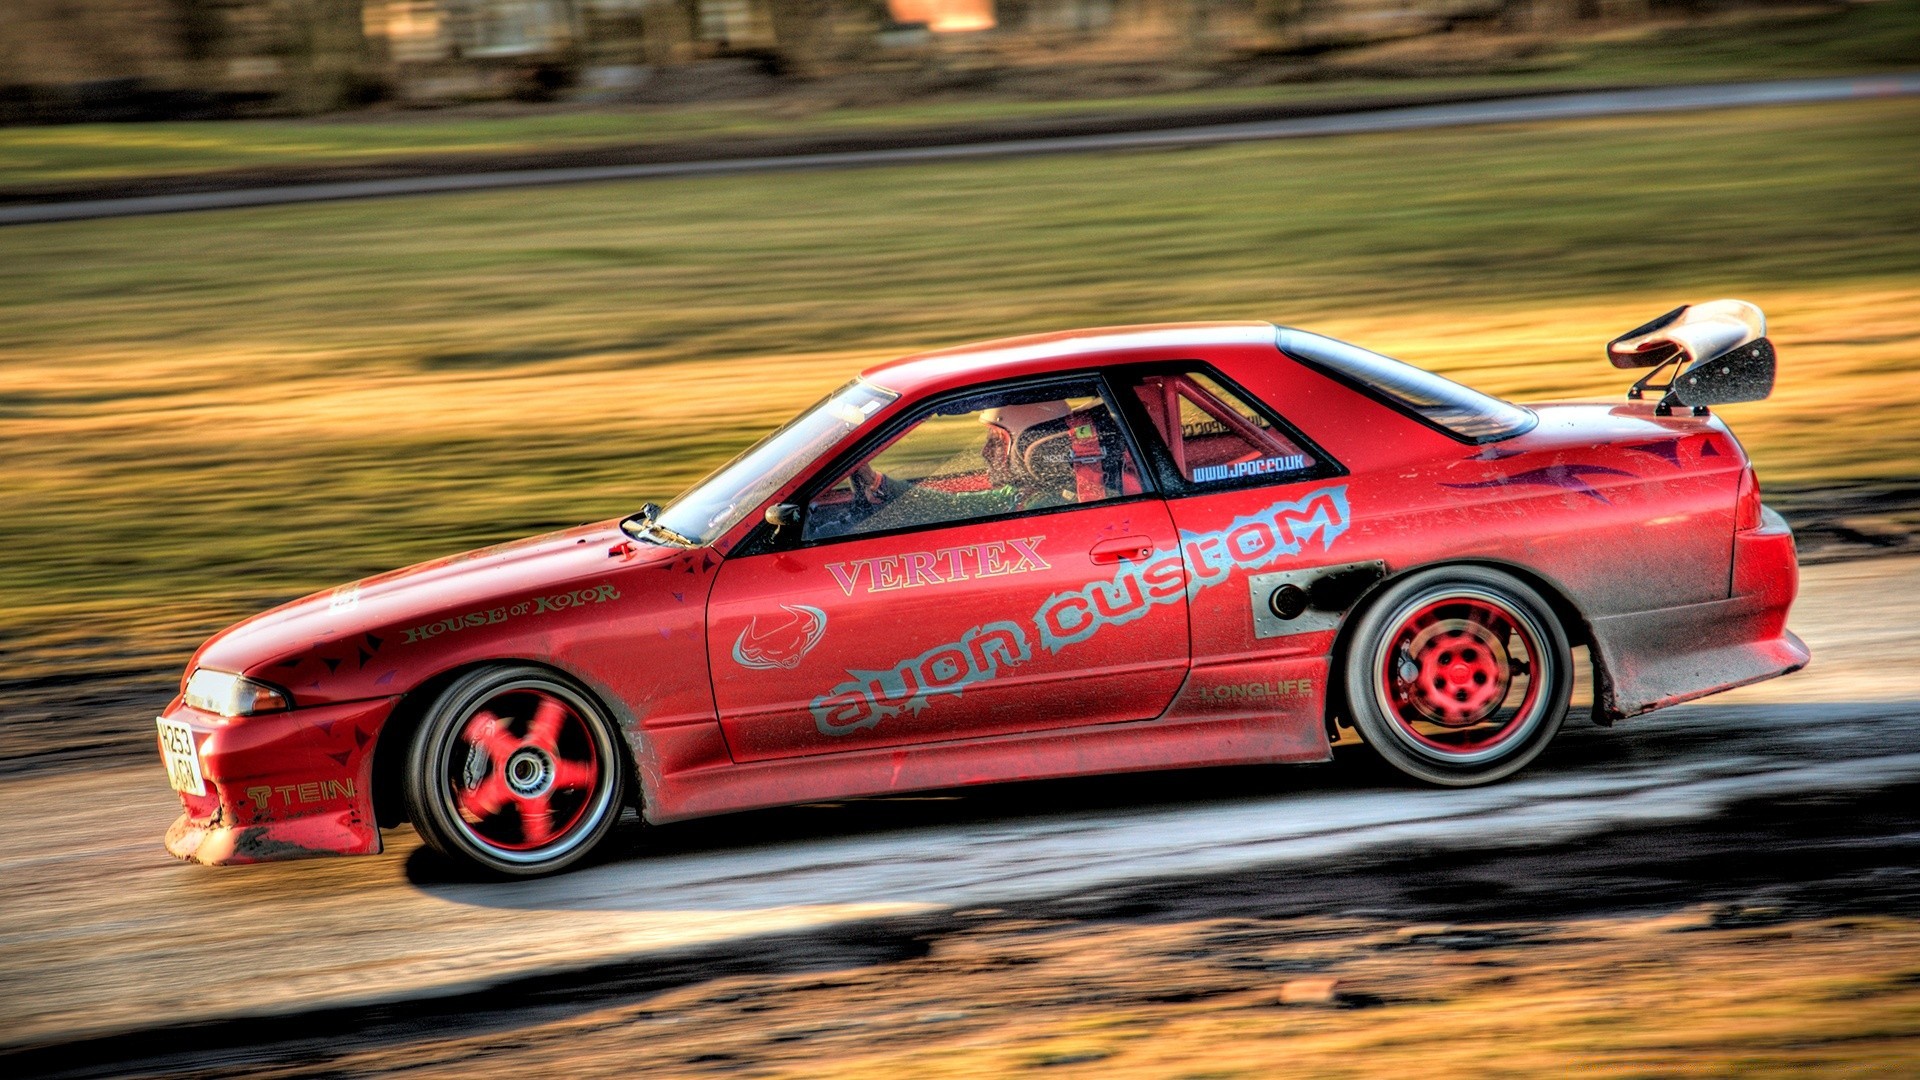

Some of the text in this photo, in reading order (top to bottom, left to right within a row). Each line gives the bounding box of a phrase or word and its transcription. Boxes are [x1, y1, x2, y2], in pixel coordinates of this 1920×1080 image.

[825, 535, 1052, 596] VERTEX
[401, 606, 508, 644] HOUSE
[532, 584, 621, 614] KOLOR
[1200, 679, 1313, 700] LONGLIFE
[159, 722, 192, 756] H253
[275, 778, 356, 806] TEIN
